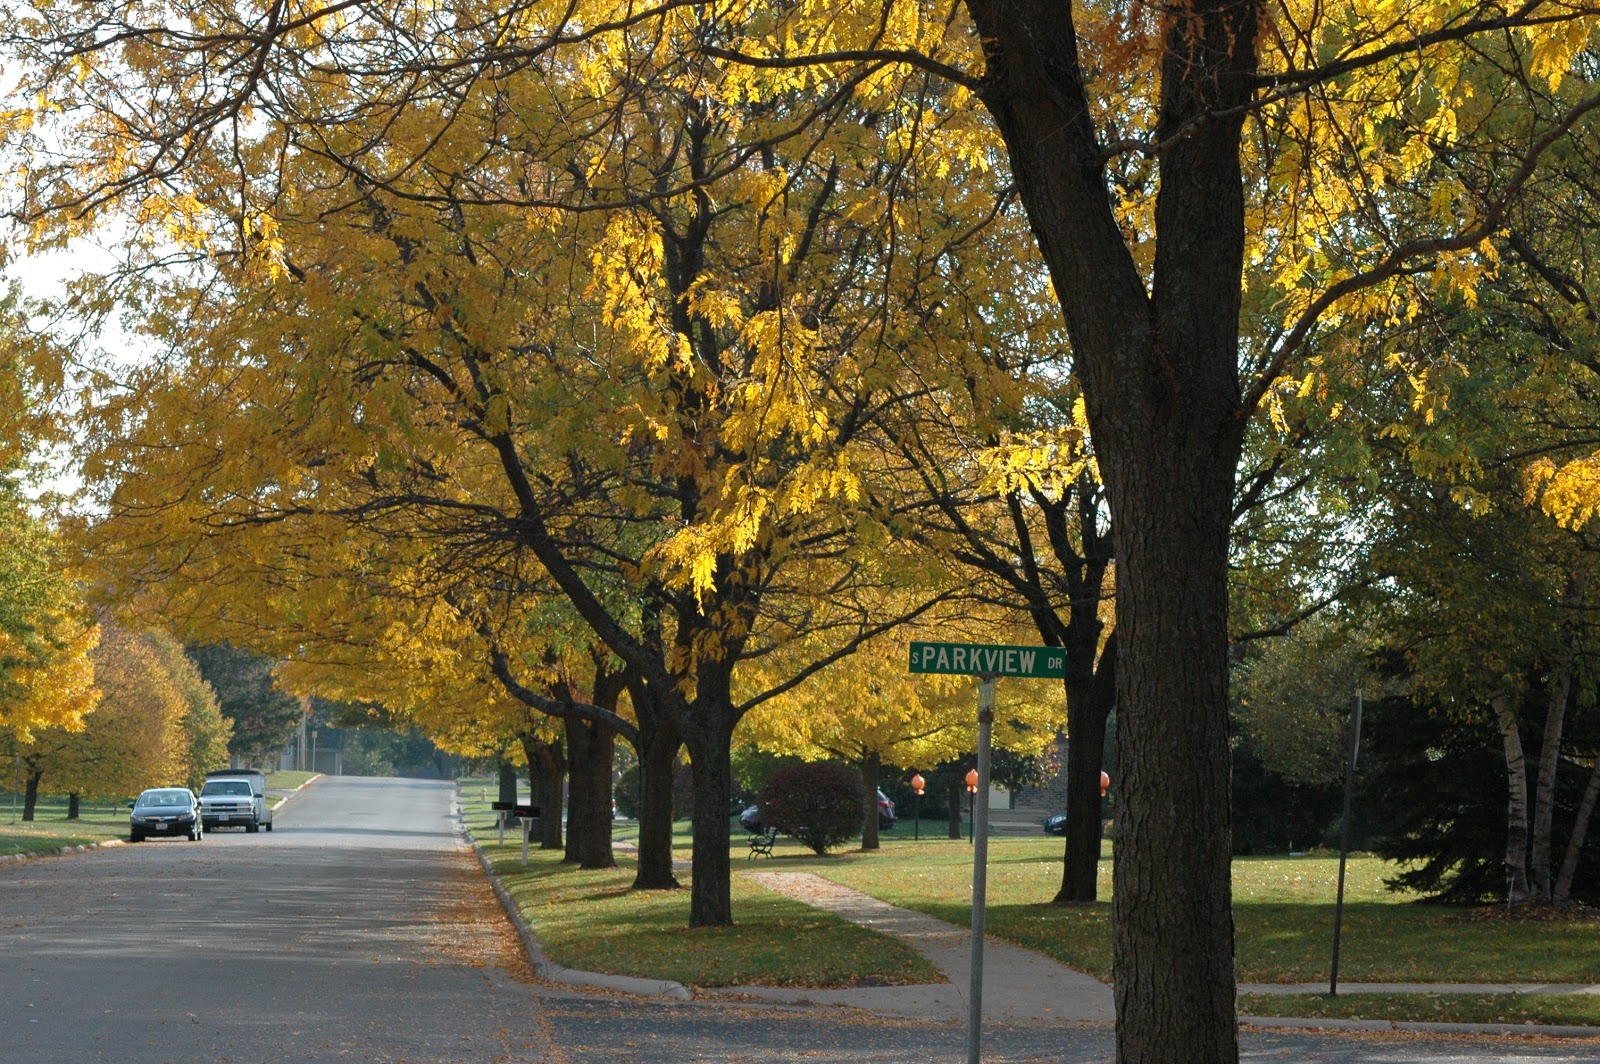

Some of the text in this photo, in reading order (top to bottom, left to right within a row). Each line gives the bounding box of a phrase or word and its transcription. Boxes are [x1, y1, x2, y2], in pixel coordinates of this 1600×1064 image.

[911, 646, 1063, 673] S PARKVIEW DR
